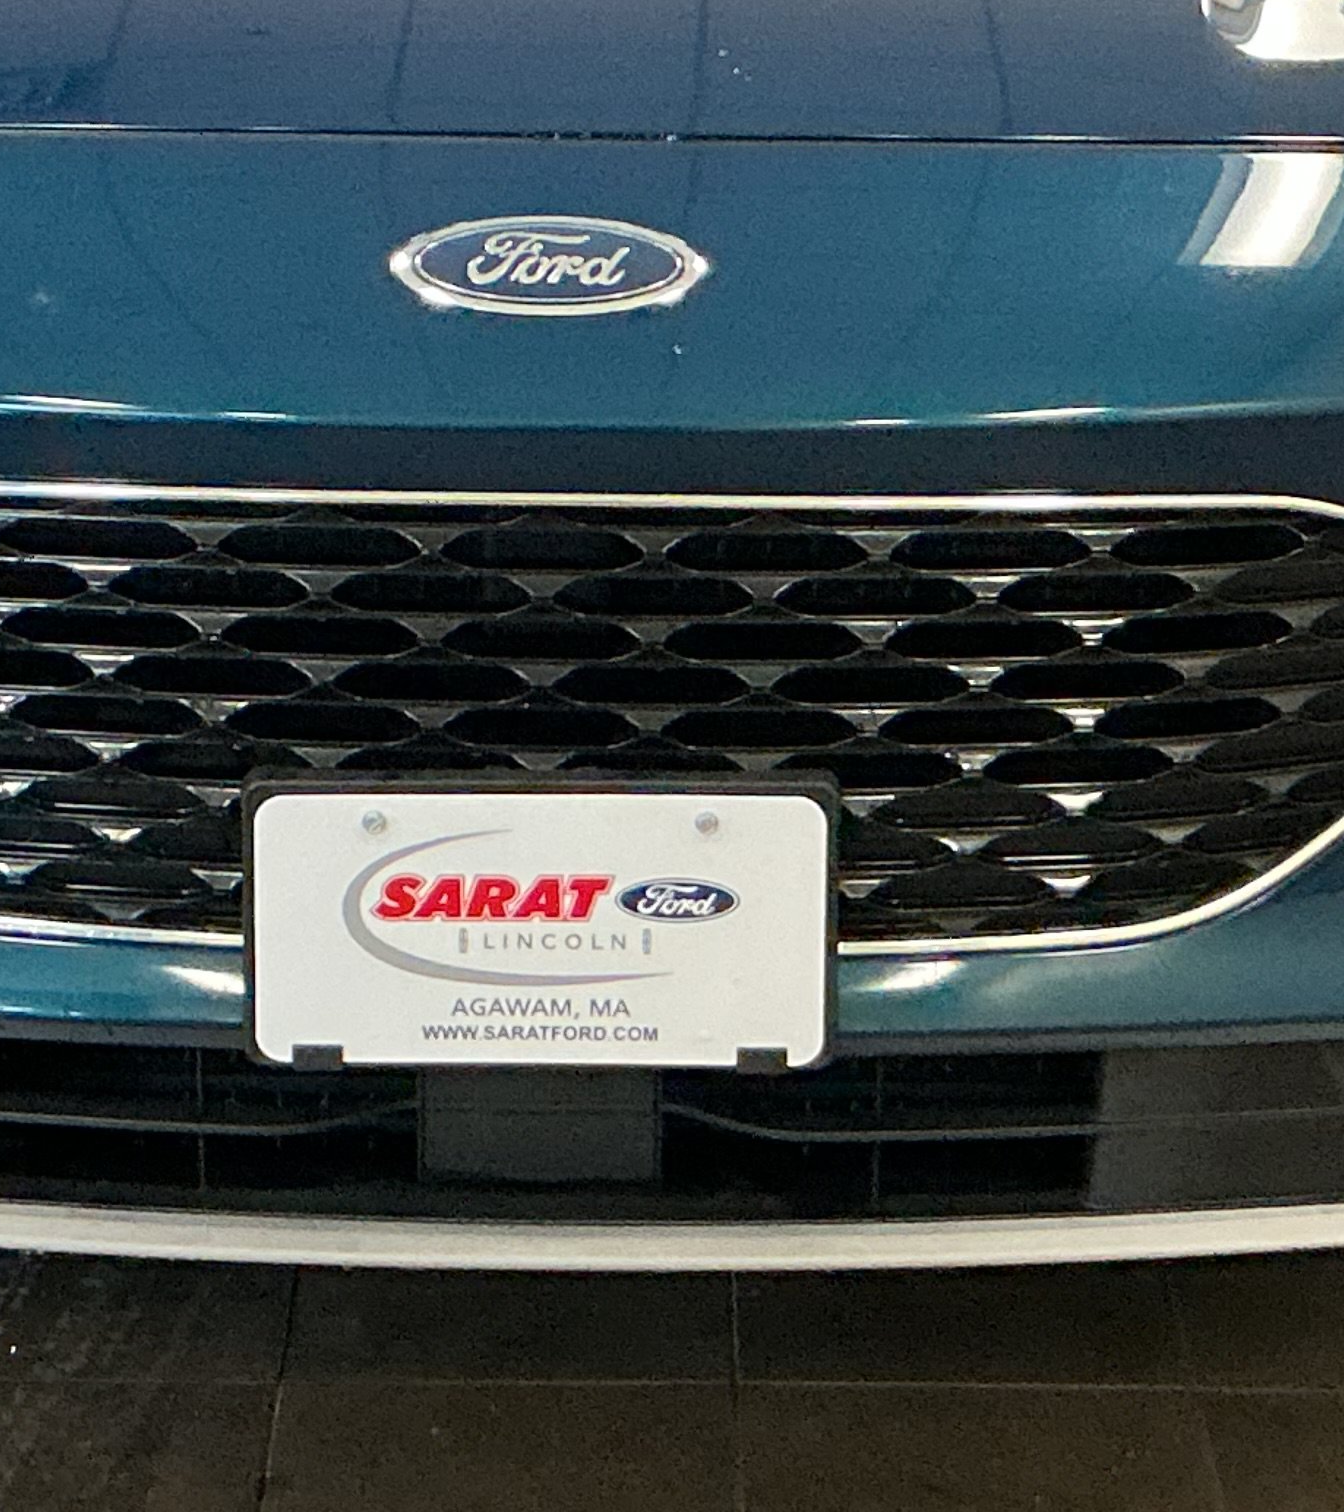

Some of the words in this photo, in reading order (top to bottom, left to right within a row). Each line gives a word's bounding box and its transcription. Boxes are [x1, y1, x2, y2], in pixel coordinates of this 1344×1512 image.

[467, 230, 630, 285] Ford
[371, 874, 612, 921] SARAT
[637, 884, 717, 915] Ford
[483, 933, 627, 950] LINCOLN
[451, 997, 580, 1019] AGAWAM,
[589, 998, 631, 1018] MA
[422, 1024, 659, 1042] WWW.SARATFORD.COM
